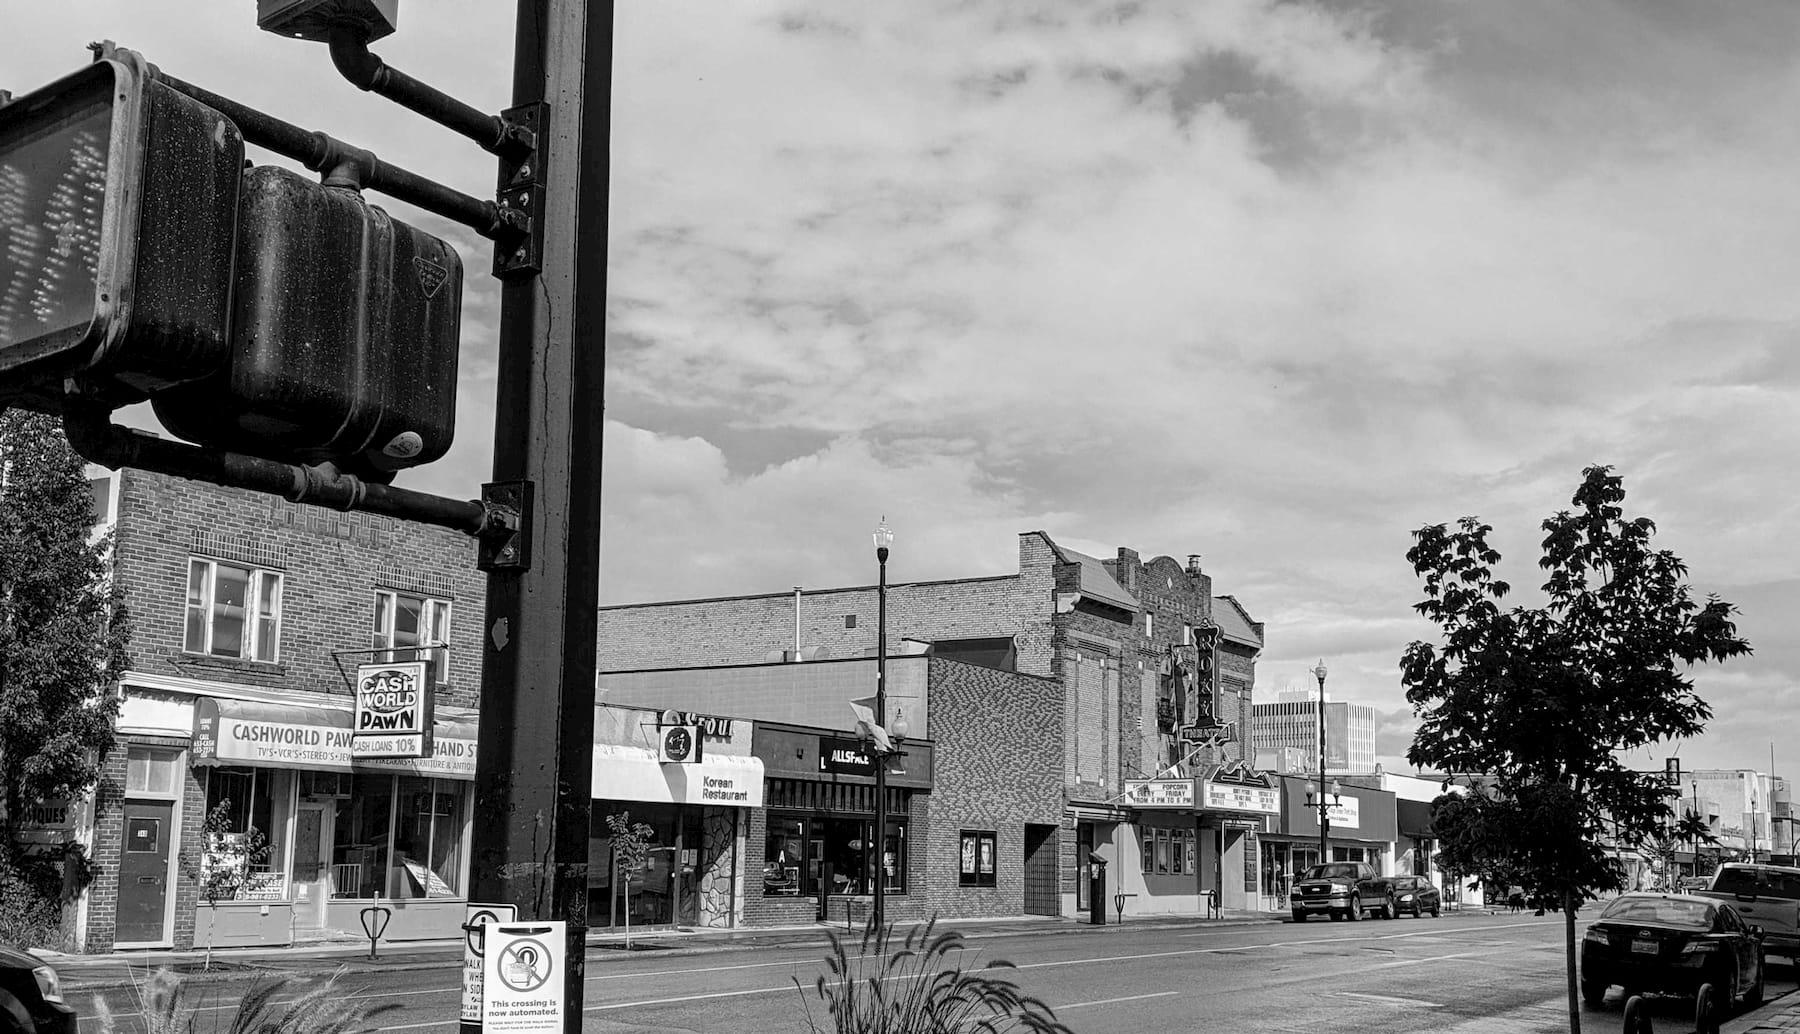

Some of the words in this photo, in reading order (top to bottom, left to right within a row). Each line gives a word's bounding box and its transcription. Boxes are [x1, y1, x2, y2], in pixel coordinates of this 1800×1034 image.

[360, 674, 417, 694] CASH
[360, 691, 417, 707] WORLD
[360, 710, 413, 729] PAWN
[232, 723, 320, 746] CASHWORLD
[325, 731, 354, 749] PAW
[354, 740, 370, 752] CASH
[371, 740, 393, 752] LOANS
[396, 738, 416, 752] 10%
[453, 761, 475, 770] ANTIQU
[703, 775, 733, 789] Korean
[702, 788, 748, 801] Restaurant
[491, 1000, 509, 1008] This
[511, 999, 547, 1008] crossing
[509, 1008, 559, 1017] automated.
